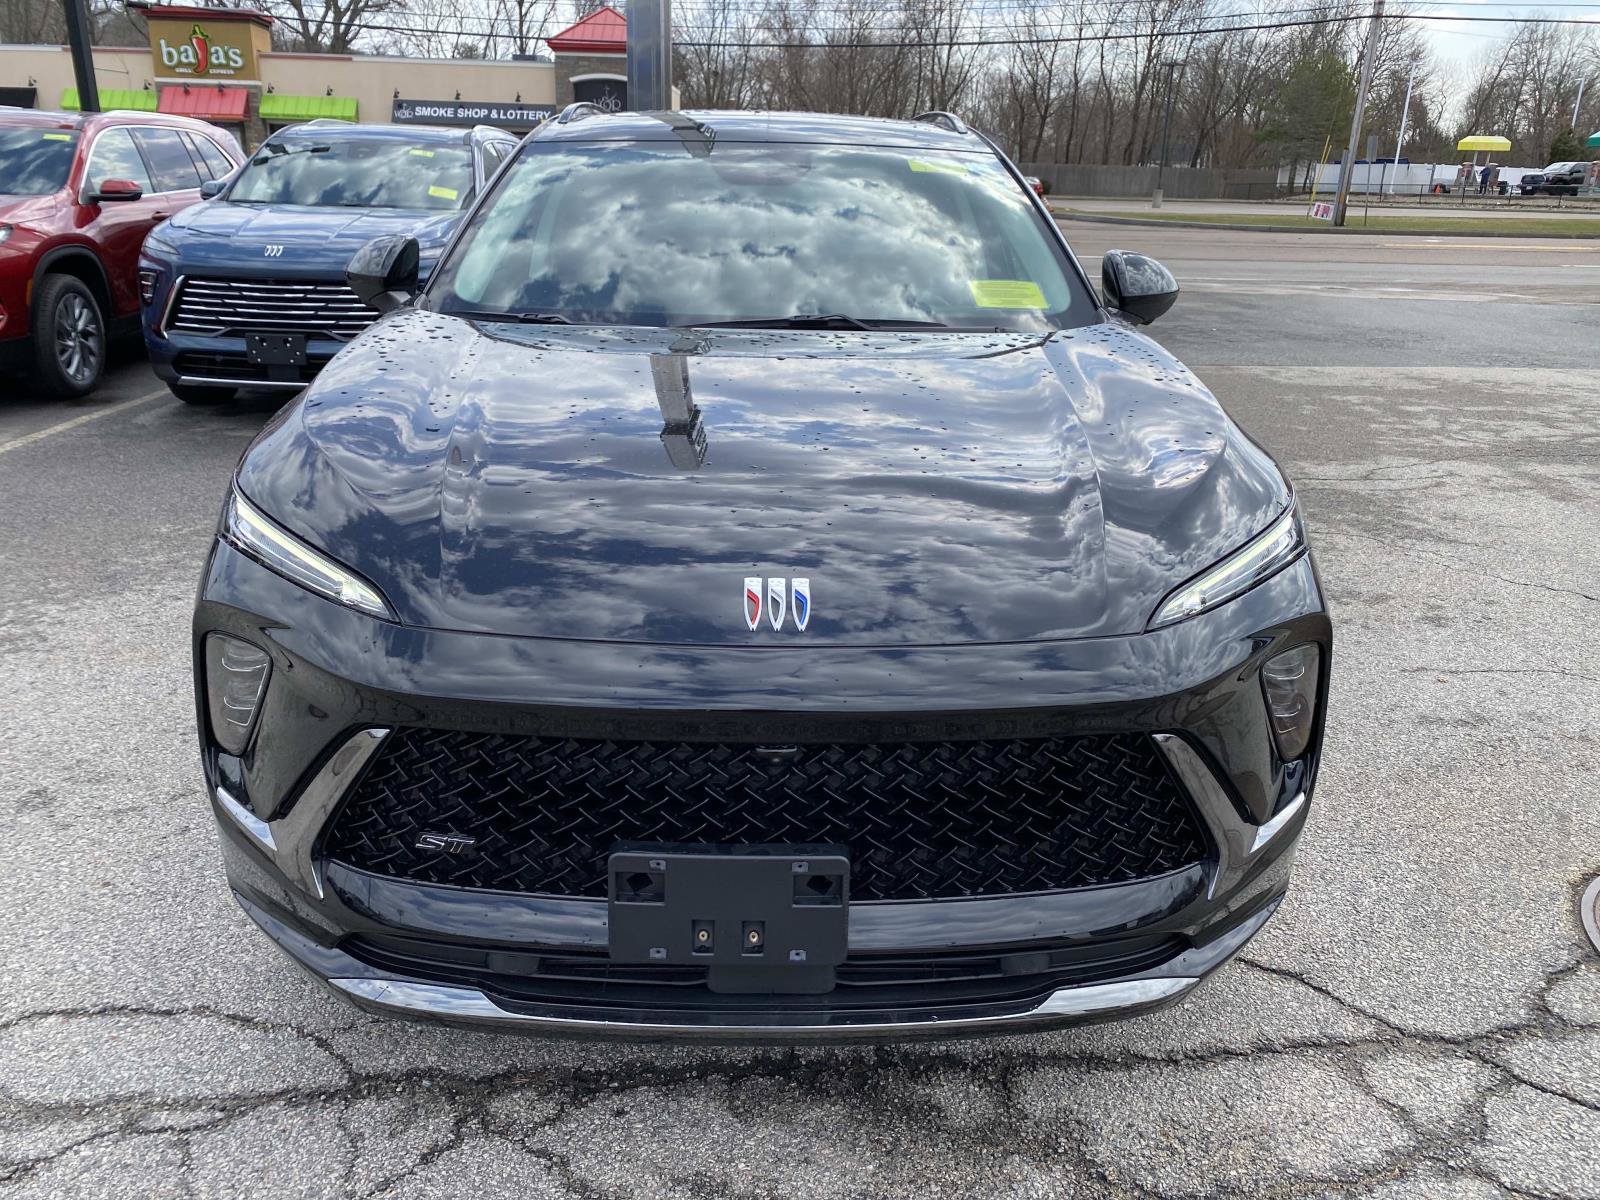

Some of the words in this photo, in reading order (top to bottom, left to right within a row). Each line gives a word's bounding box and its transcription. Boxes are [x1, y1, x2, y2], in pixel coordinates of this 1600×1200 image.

[415, 106, 454, 117] SMOKE
[457, 107, 488, 118] SHOP
[490, 109, 498, 118] &
[500, 109, 551, 120] LOTTERY
[415, 833, 475, 853] ST
